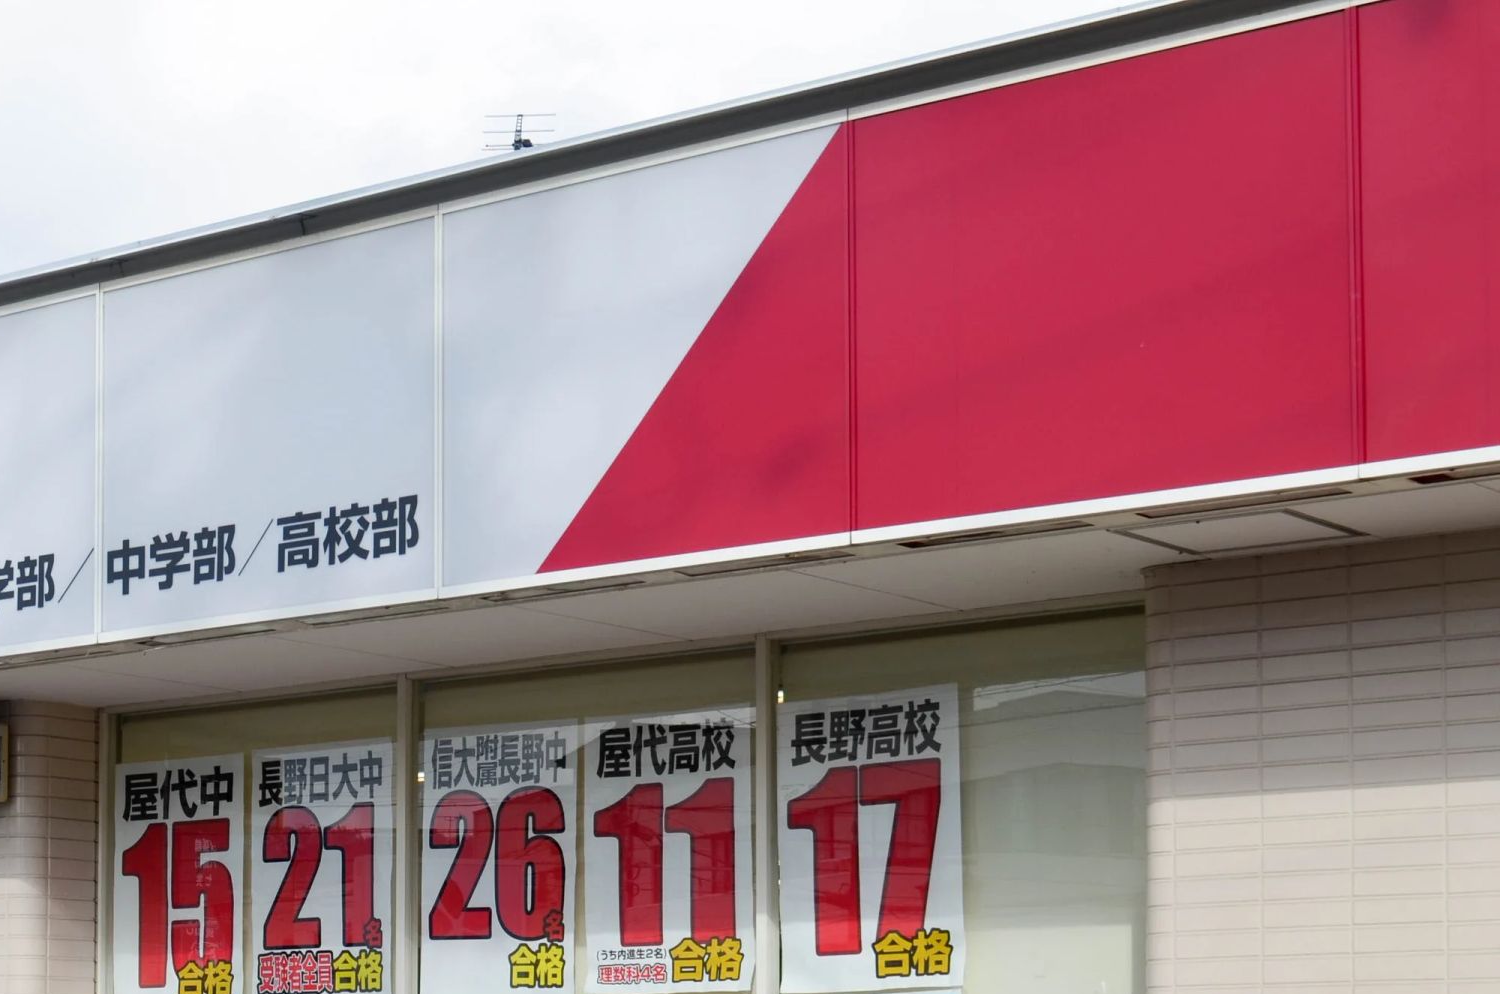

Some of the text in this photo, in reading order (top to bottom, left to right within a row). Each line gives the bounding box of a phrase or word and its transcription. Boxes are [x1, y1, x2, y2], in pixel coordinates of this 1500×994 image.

[597, 722, 737, 778] 屋代高校
[791, 699, 942, 767] 長野高校
[122, 765, 234, 822] 屋代中
[258, 750, 382, 808] 長野日大中
[593, 777, 737, 947] 11
[787, 757, 942, 957] 17
[122, 817, 235, 989] 15
[508, 943, 565, 988] 合格
[669, 936, 745, 983] 合格
[872, 928, 953, 979] 合格
